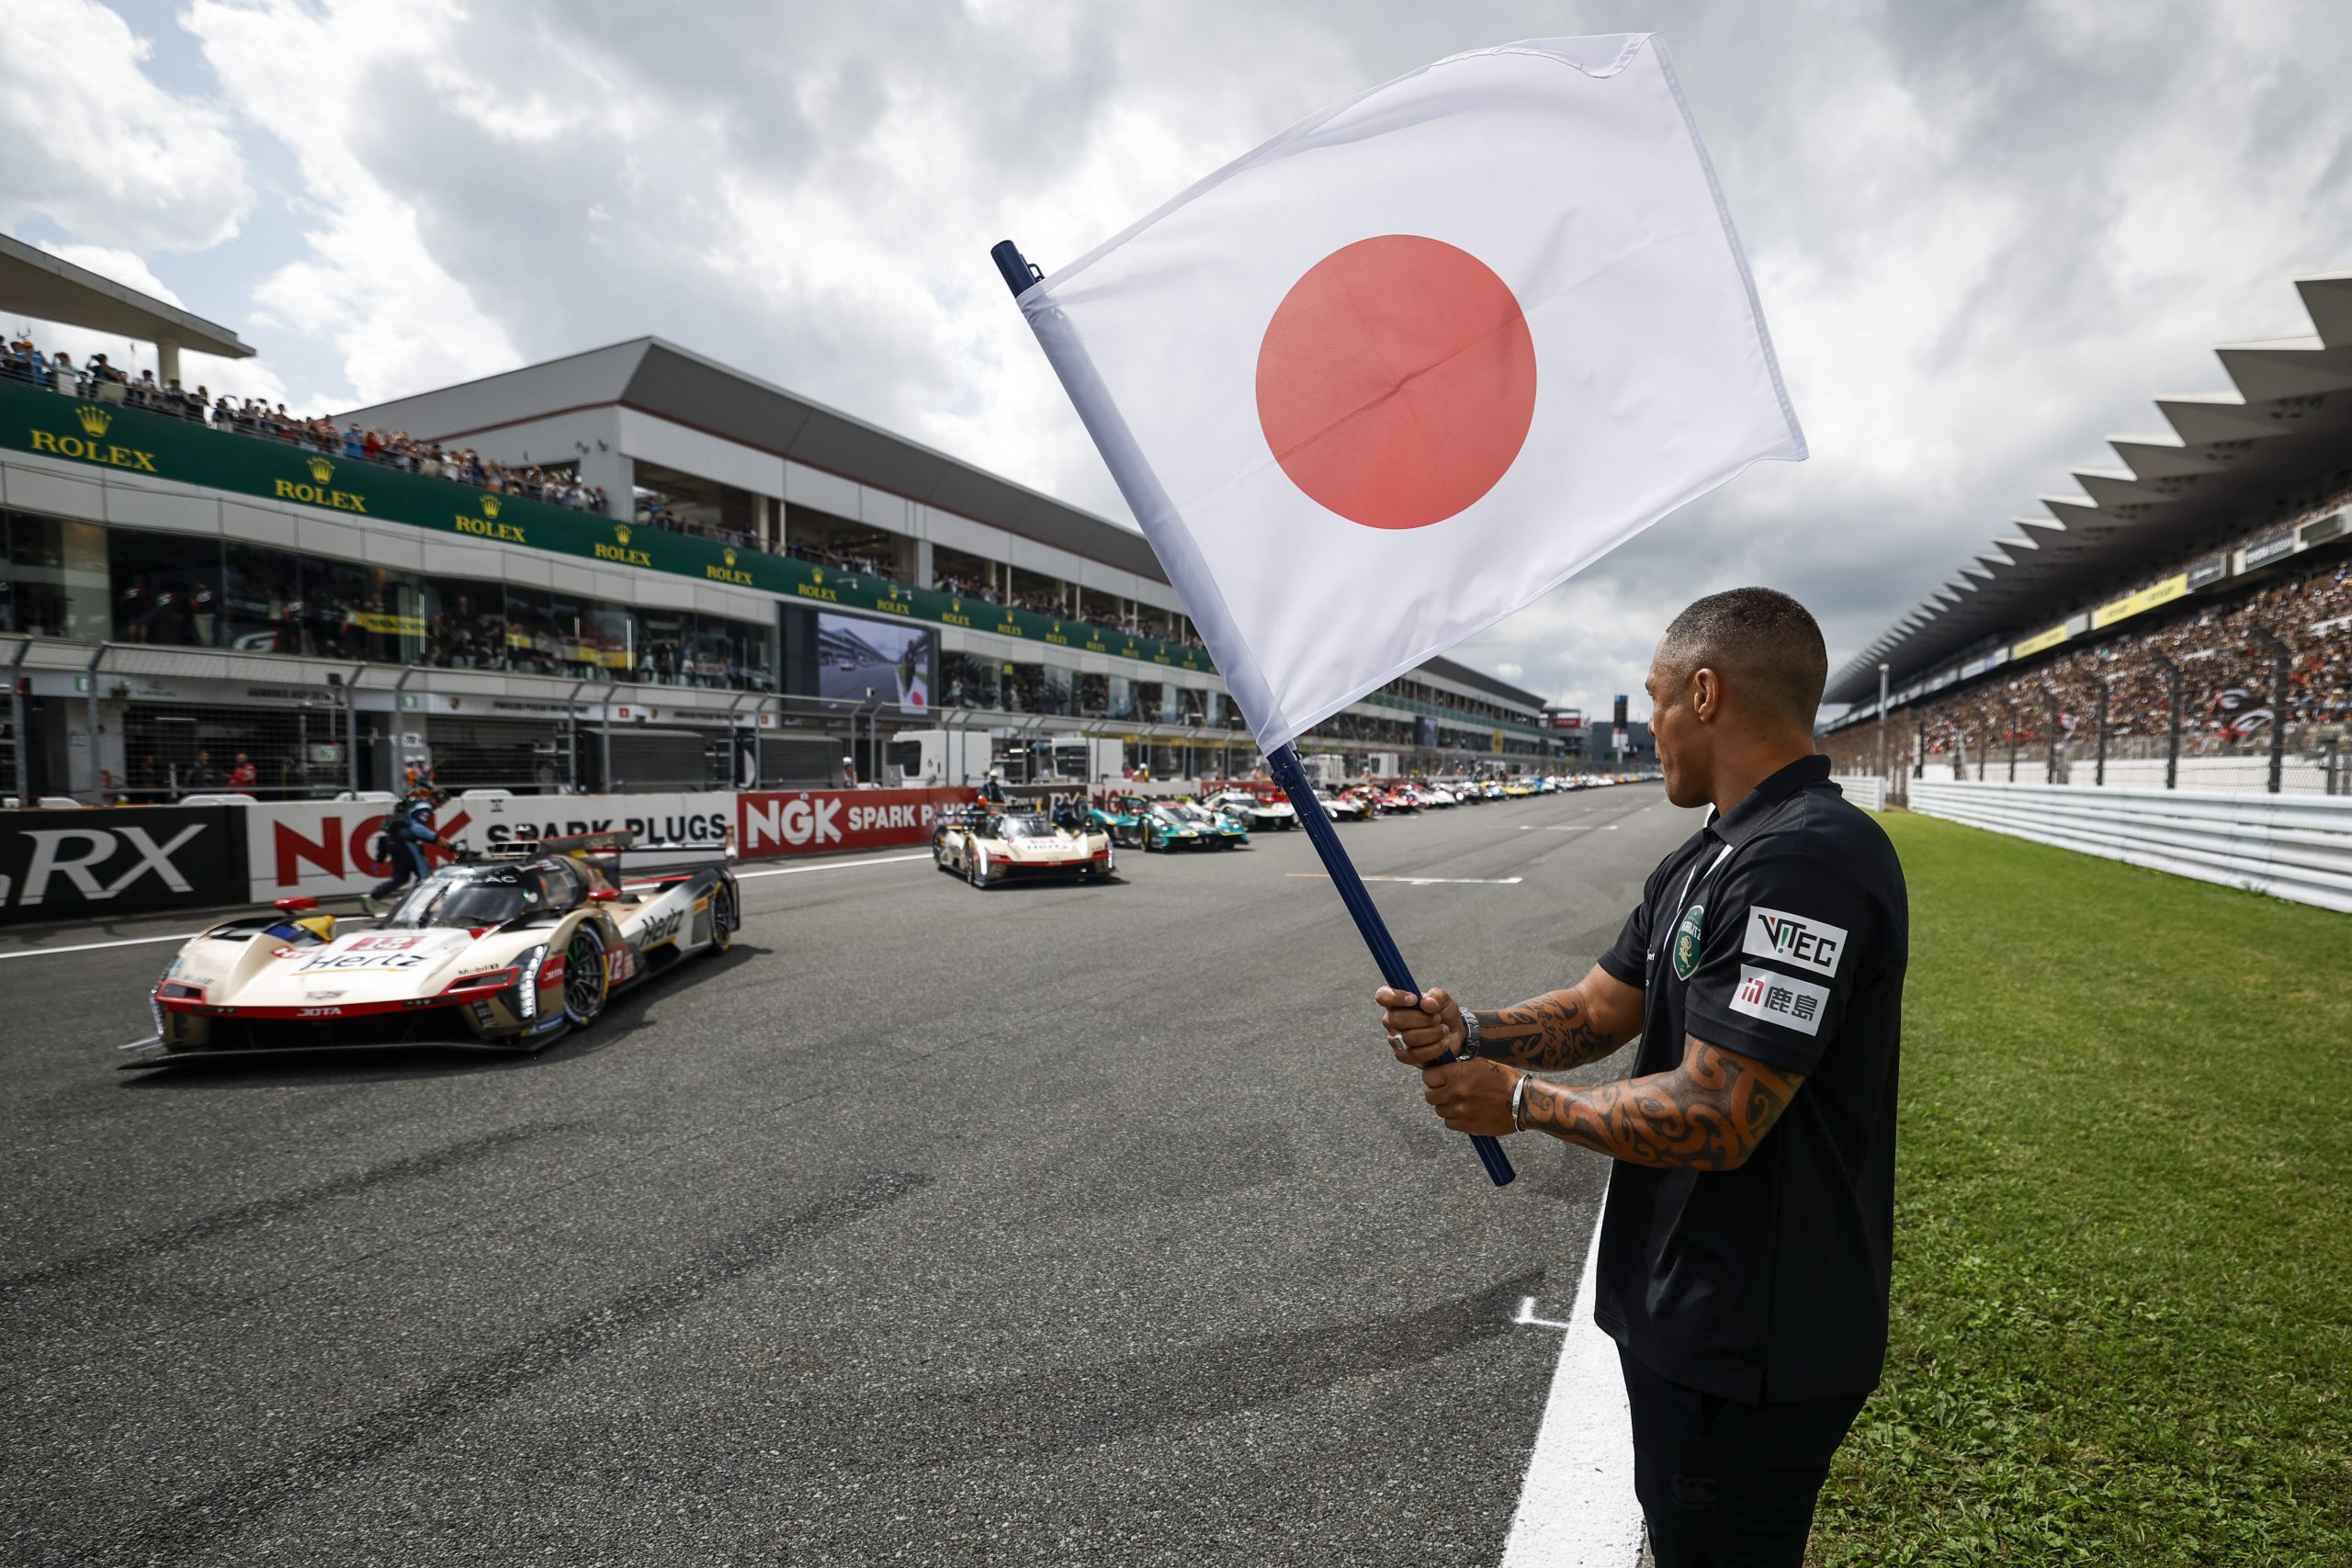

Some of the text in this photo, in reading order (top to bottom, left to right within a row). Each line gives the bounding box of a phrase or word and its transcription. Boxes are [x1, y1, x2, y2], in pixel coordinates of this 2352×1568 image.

[30, 429, 157, 472] ROLEX
[275, 479, 368, 513] ROLEX
[455, 514, 527, 543] ROLEX
[594, 542, 651, 568] ROLEX
[706, 564, 753, 586] ROLEX
[797, 583, 837, 602] ROLEX
[876, 599, 910, 615] ROLEX
[942, 612, 970, 626] ROLEX
[997, 623, 1022, 636] ROLEX
[1092, 789, 1135, 815] NG
[630, 813, 726, 843] PLUGS
[746, 797, 974, 849] NGK SPARK PUG
[640, 908, 686, 945] Hertz
[299, 953, 431, 972] Hertz
[607, 949, 624, 981] 12
[297, 1007, 343, 1018] JOTA
[1764, 986, 1818, 1021] 鹿島
